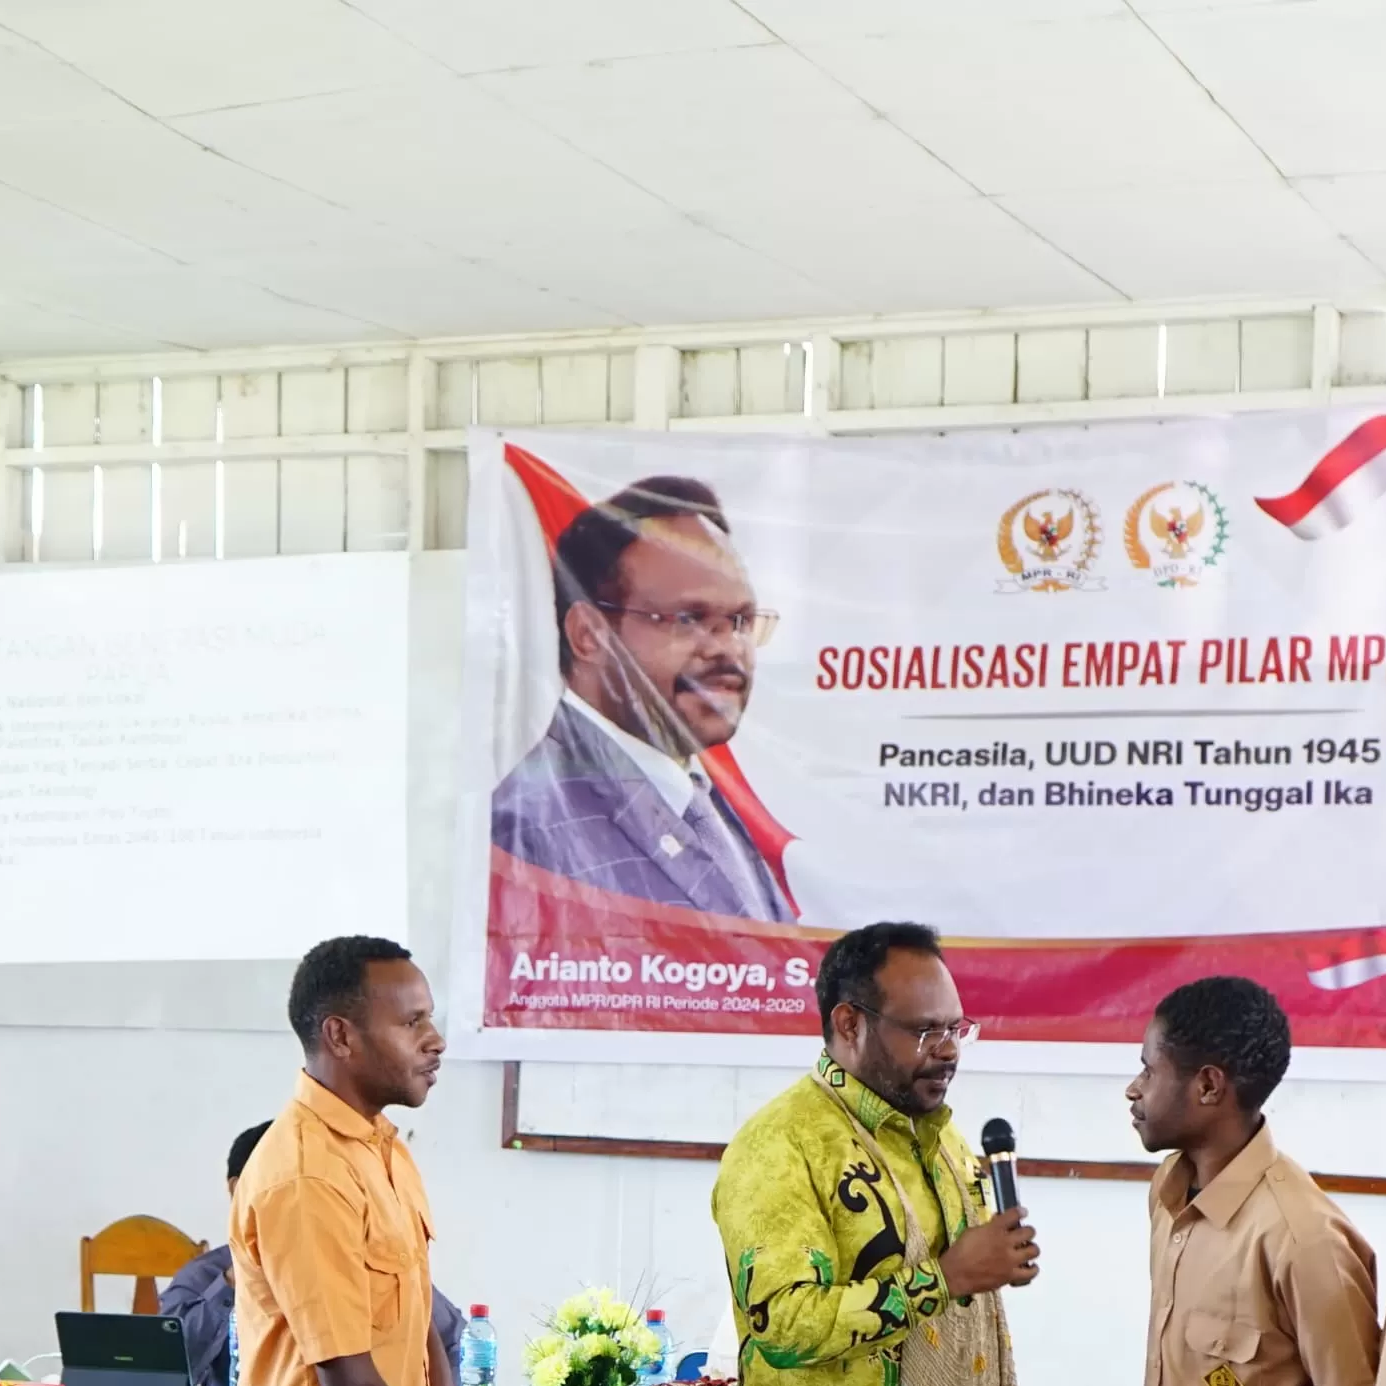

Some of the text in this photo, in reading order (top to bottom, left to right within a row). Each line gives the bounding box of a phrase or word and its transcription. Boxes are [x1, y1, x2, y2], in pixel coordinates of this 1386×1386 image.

[816, 643, 1049, 691] SOSIALISASI
[1061, 639, 1187, 688] EMPAT
[1198, 635, 1314, 684] PILAR
[879, 738, 1381, 771] Pancasila, UUD NRI Tahun 1945
[883, 780, 1374, 812] NKRI, dan Bhineka Tunggal Ika
[509, 951, 634, 983] Arianto
[640, 955, 776, 992] Kogoya,
[509, 991, 806, 1013] Anggota MPR/DPR RI Periode 2024-2029
